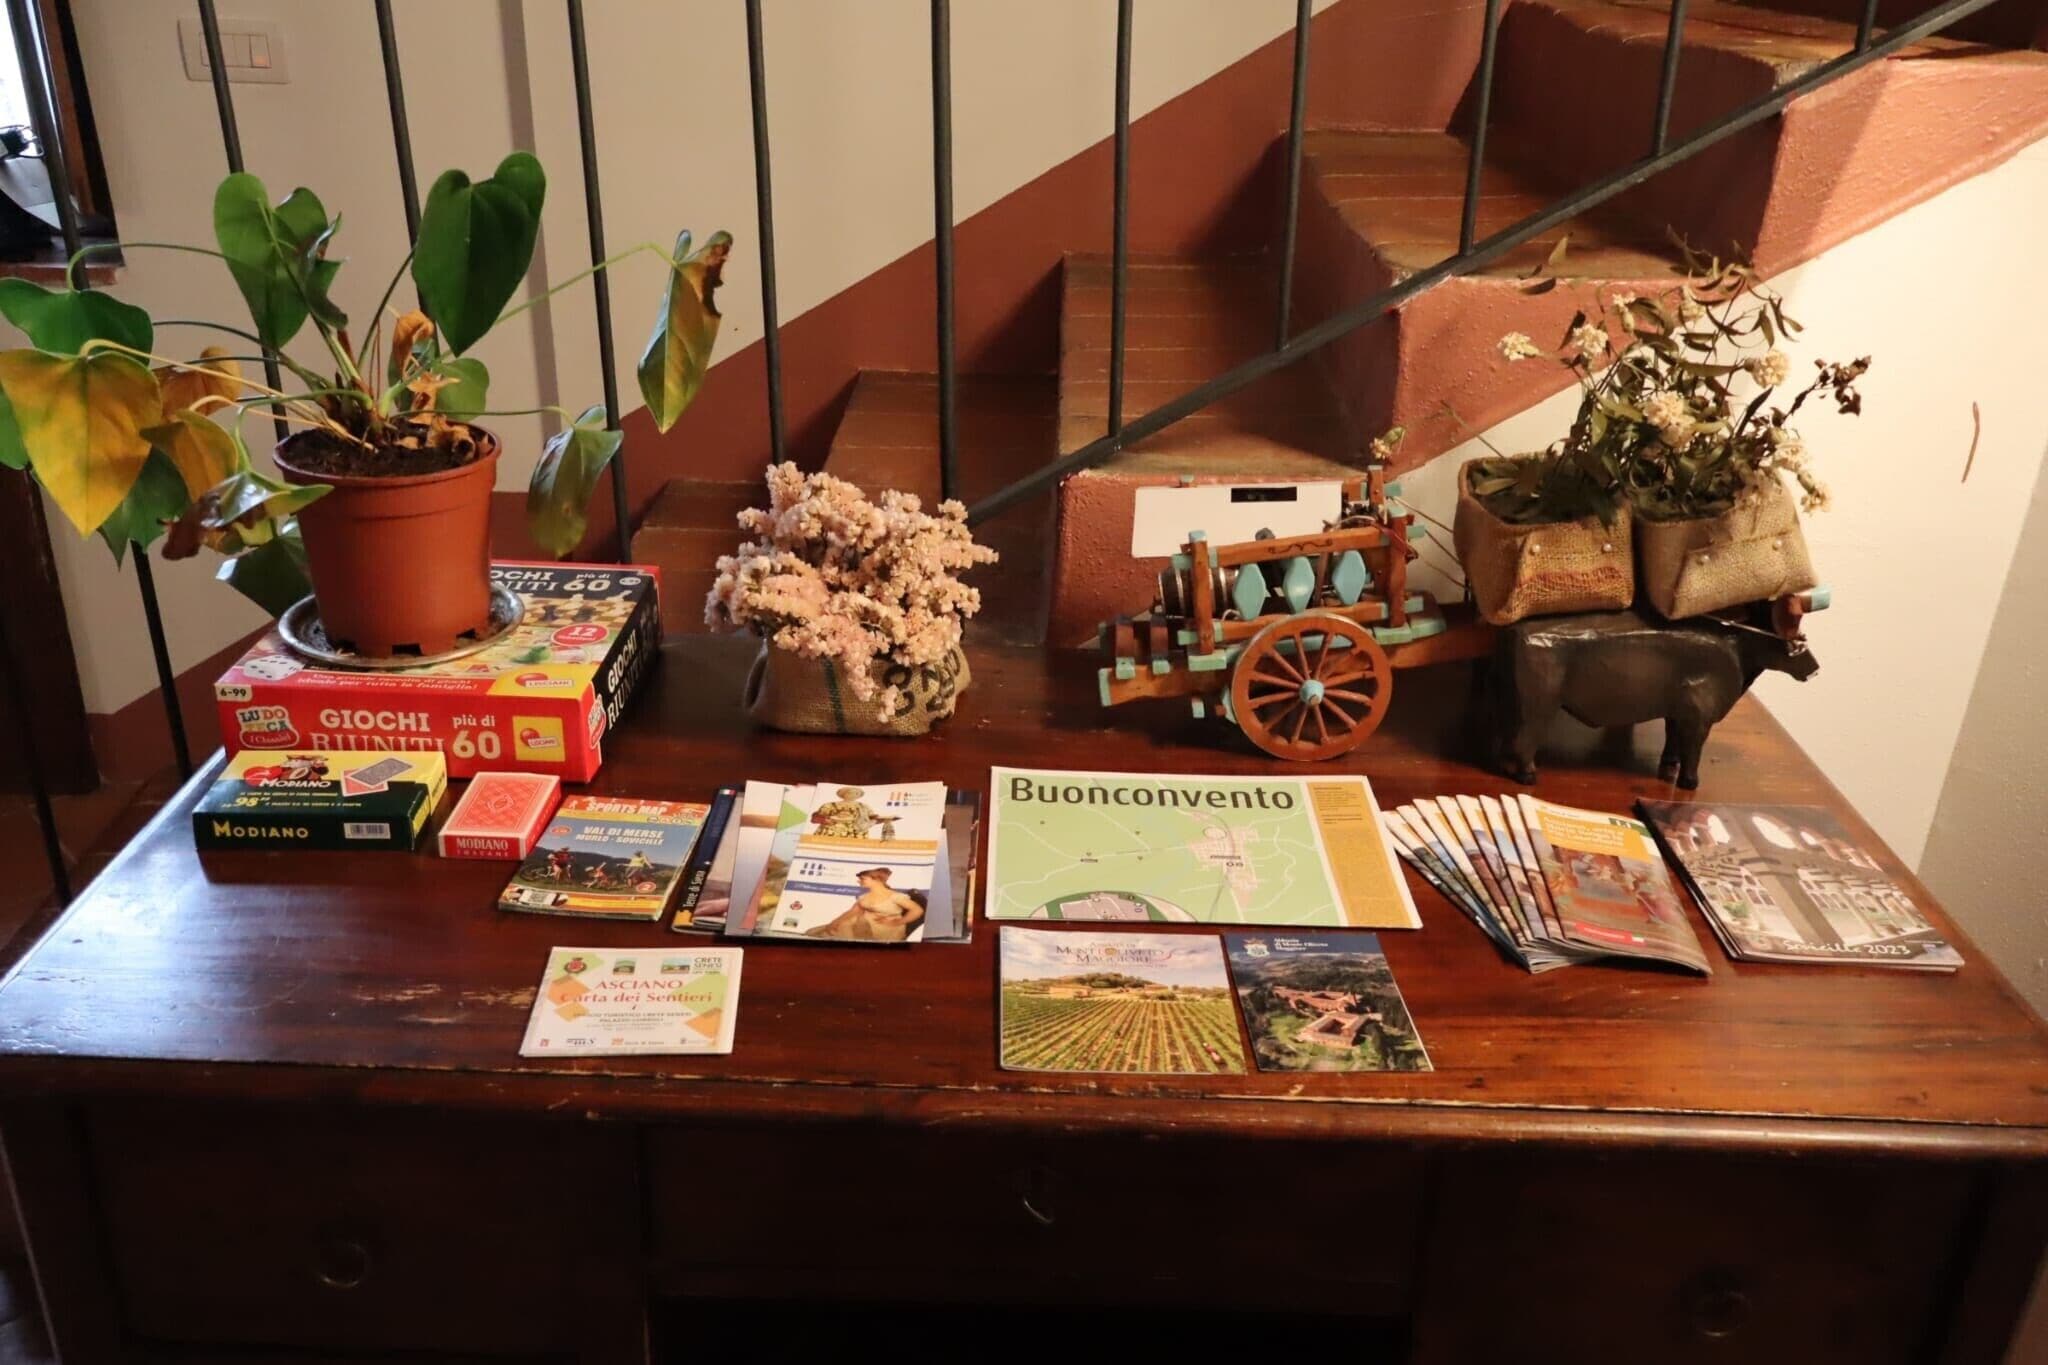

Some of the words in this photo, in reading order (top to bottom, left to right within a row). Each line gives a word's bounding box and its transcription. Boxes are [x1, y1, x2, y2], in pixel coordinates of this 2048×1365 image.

[491, 570, 554, 581] OCHI
[563, 579, 611, 591] 60
[568, 627, 598, 636] 12
[608, 629, 637, 693] GIOCHI
[220, 688, 247, 698] 6-99
[240, 709, 286, 723] LUDO
[319, 708, 431, 733] GIOCHI
[453, 714, 476, 728] più
[481, 715, 496, 727] di
[310, 732, 446, 752] RIUNITI
[452, 730, 501, 760] 60
[259, 778, 331, 788] MODIANO
[1011, 777, 1294, 809] Buonconvento
[586, 802, 638, 814] SPORTS
[639, 805, 667, 815] MAP
[212, 819, 309, 839] MODIANO
[584, 826, 605, 835] VAL
[607, 827, 621, 836] DI
[623, 828, 665, 838] MERSE
[456, 837, 509, 850] MODIANO
[1864, 944, 1910, 955] 2023
[596, 979, 683, 989] ASCIANO
[560, 992, 607, 1002] Carta
[614, 992, 640, 1002] dei
[647, 992, 713, 1003] Sentieri
